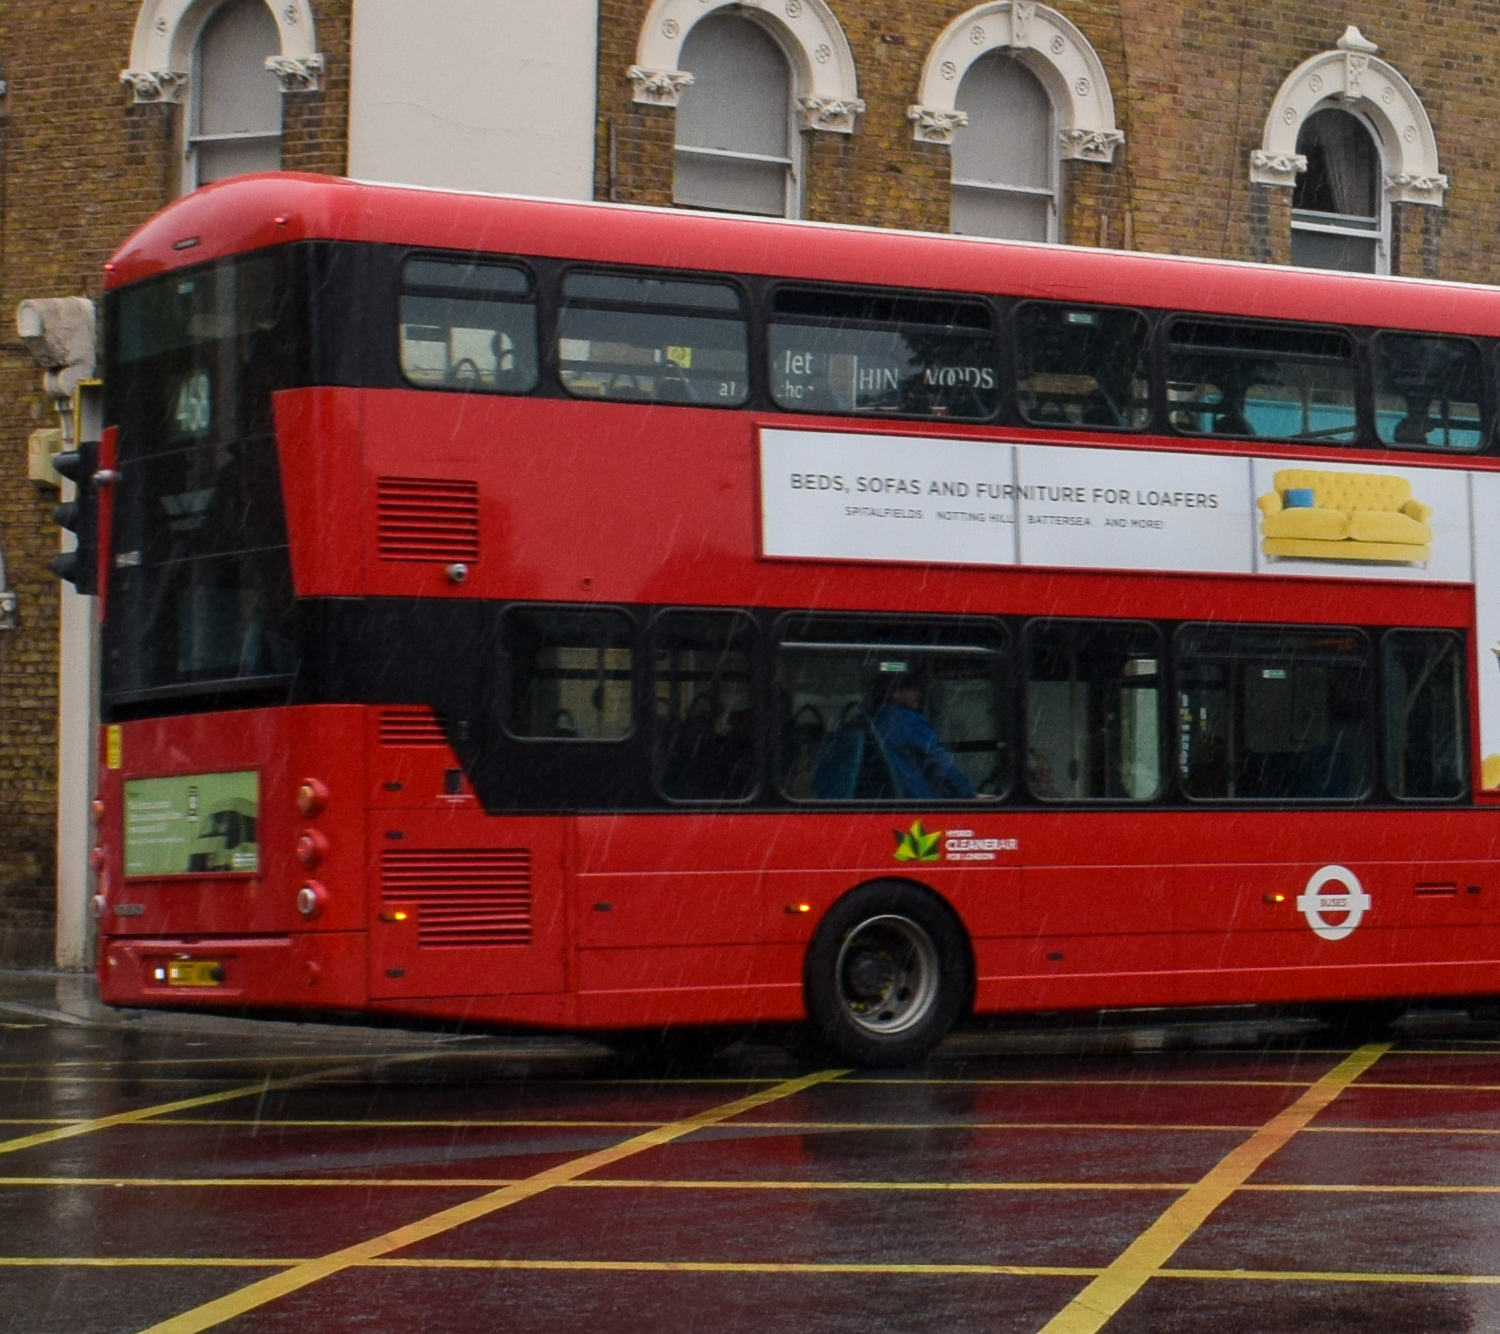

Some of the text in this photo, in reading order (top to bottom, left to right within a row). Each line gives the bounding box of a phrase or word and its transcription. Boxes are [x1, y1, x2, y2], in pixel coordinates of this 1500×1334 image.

[791, 473, 1220, 509] BEDS, SOFAS AND FURNITURE FOR LOAFERS
[844, 506, 924, 519] SPITALFIELDS
[934, 511, 985, 523] NOTTING
[1027, 514, 1092, 527] BATTERSEA
[1104, 518, 1126, 528] AND
